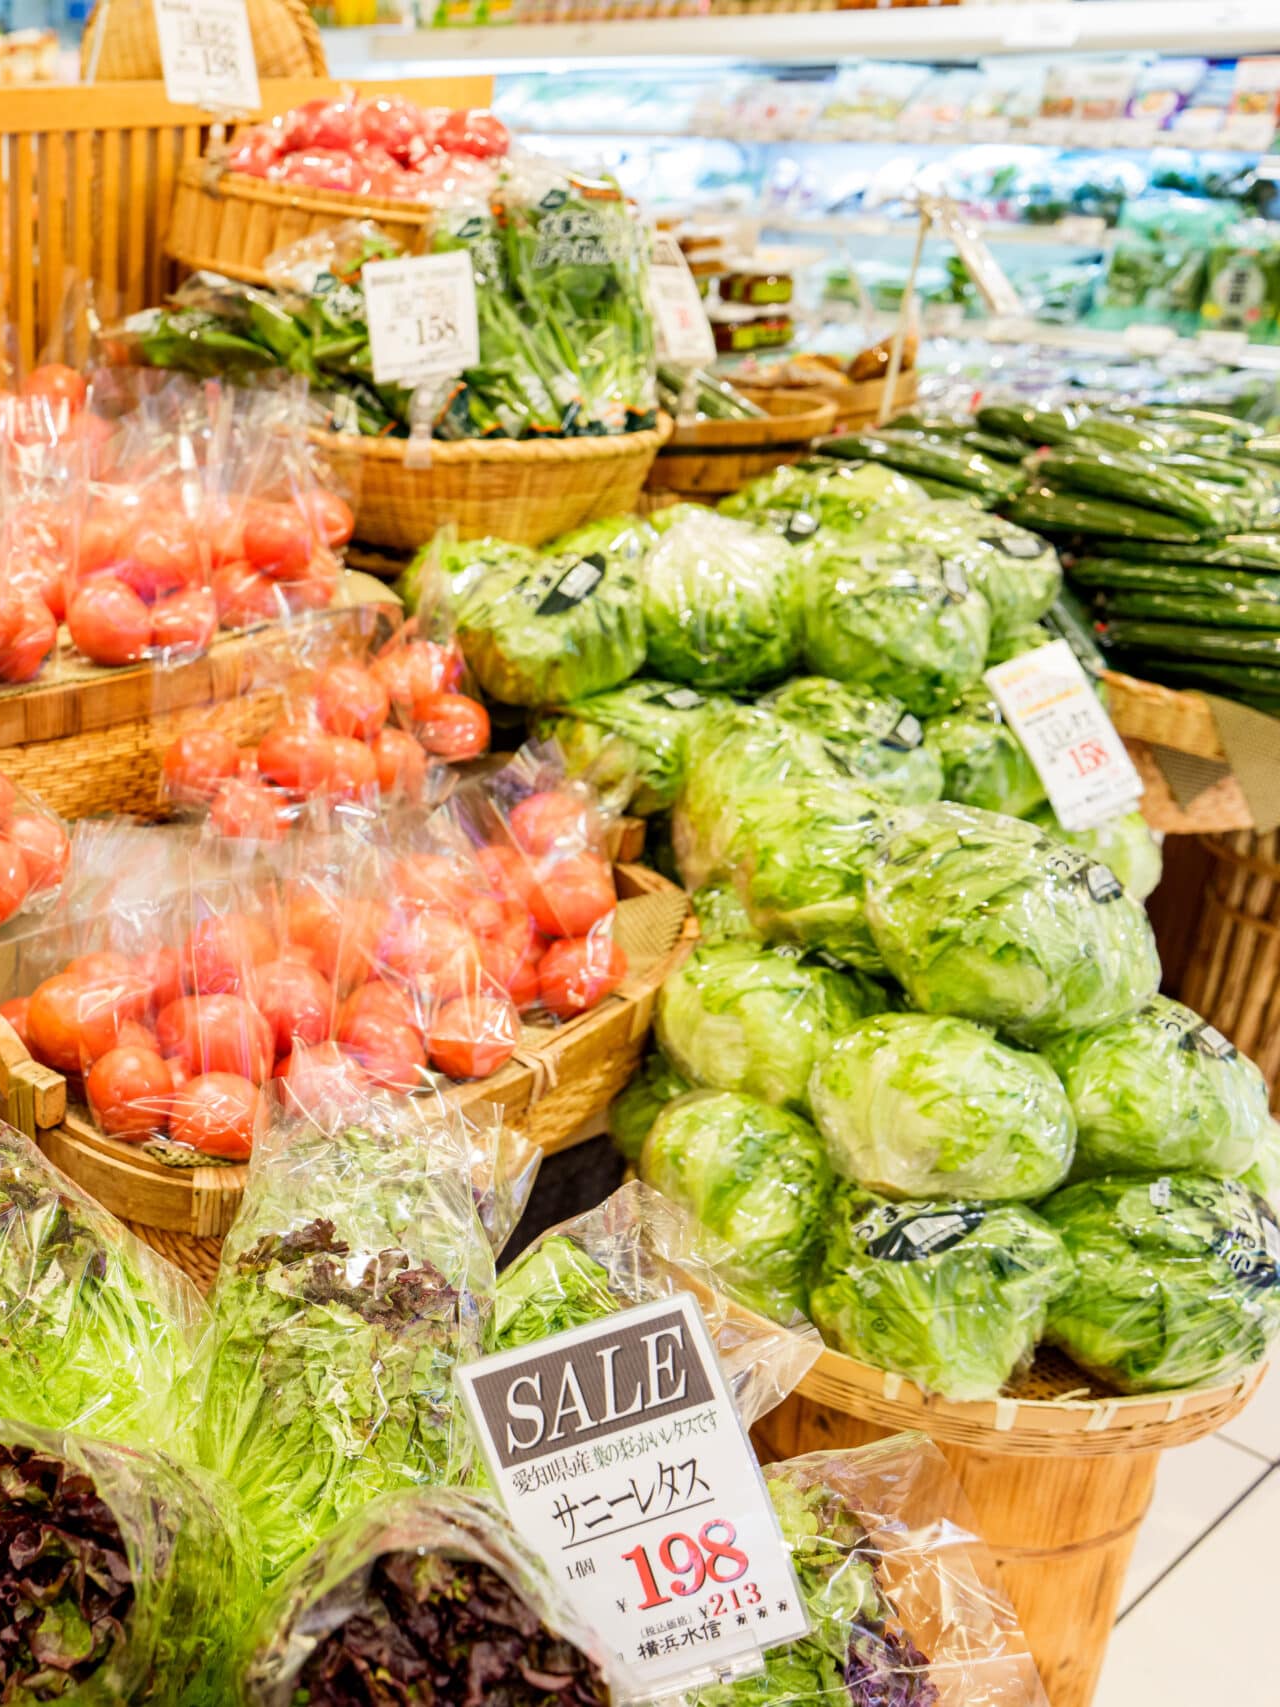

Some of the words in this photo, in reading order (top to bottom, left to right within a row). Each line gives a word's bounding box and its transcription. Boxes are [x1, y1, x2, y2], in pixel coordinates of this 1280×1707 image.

[1068, 738, 1109, 776] 158
[507, 1324, 687, 1455] SALE
[512, 1450, 595, 1496] 愛知県産
[552, 1457, 711, 1544] サニーレタス
[637, 1619, 722, 1660] 横浜水信
